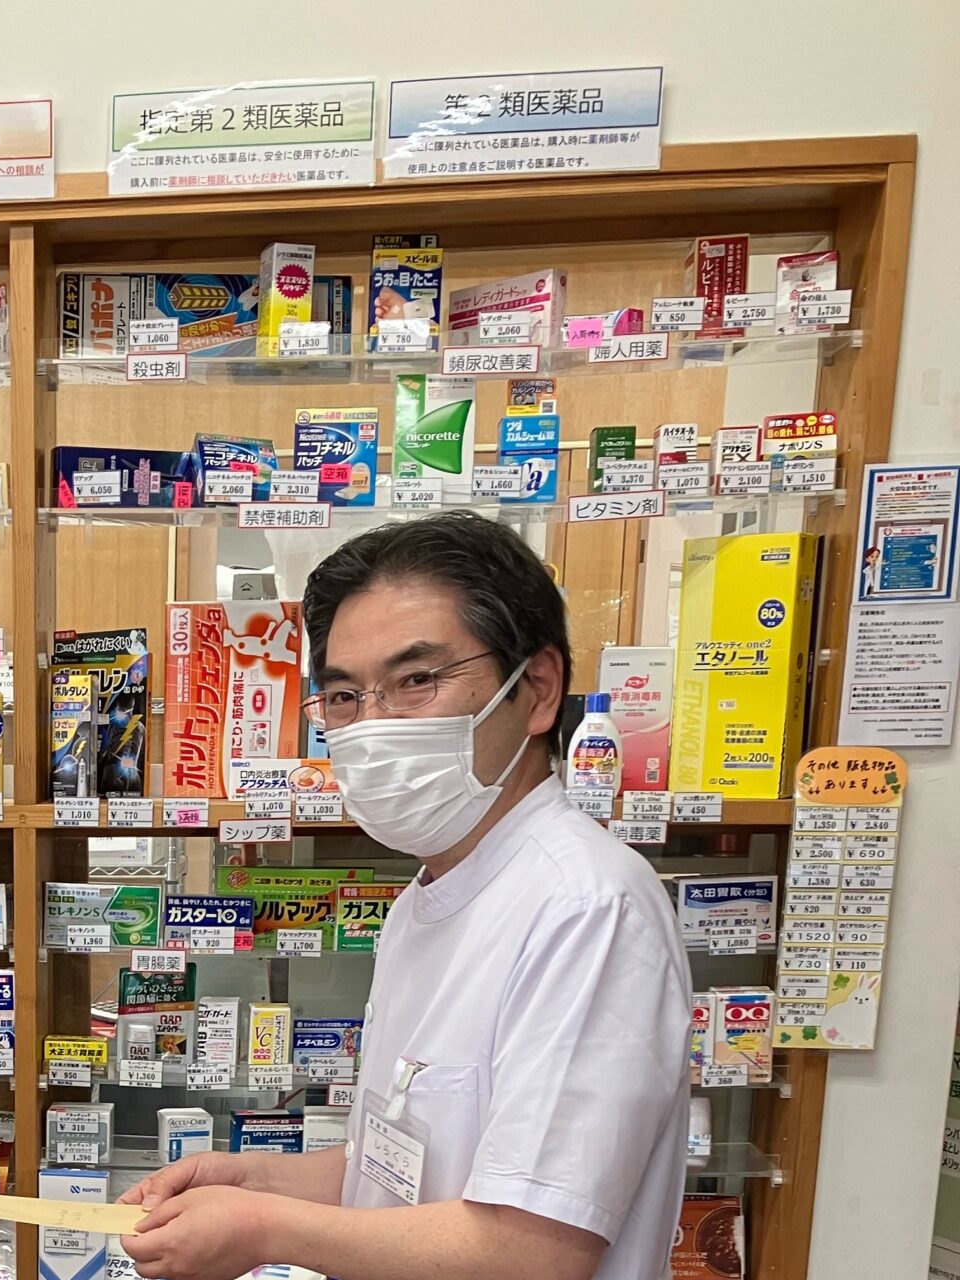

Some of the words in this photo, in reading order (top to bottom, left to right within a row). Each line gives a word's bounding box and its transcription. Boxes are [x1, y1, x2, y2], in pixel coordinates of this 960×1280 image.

[594, 340, 662, 360] 婦人用薬
[132, 361, 180, 377] 殺虫剤
[449, 354, 533, 372] 頻尿改善薬
[406, 431, 460, 441] nicorette
[297, 440, 355, 456] ニコチネル
[779, 440, 823, 451] ナポリンS
[297, 455, 322, 466] パッチ
[323, 468, 349, 480] 空箱
[575, 498, 658, 518] ビタミン剤
[245, 511, 323, 526] 禁煙補助剤
[760, 607, 783, 619] 80%
[746, 639, 771, 649] one2
[695, 651, 768, 667] エタノール
[240, 770, 288, 780] 口内炎治療薬
[240, 778, 288, 788] アフタッチA
[718, 778, 738, 786] Osaki
[824, 777, 869, 791] あります
[226, 824, 287, 840] シップ薬
[614, 825, 661, 841] 消毒薬
[859, 849, 885, 858] 690
[47, 906, 100, 917] セレキノンS
[168, 908, 237, 923] ガスター10
[797, 932, 831, 941] 1520
[851, 933, 867, 942] 90
[136, 954, 185, 971] 胃腸薬
[796, 960, 821, 969] 730
